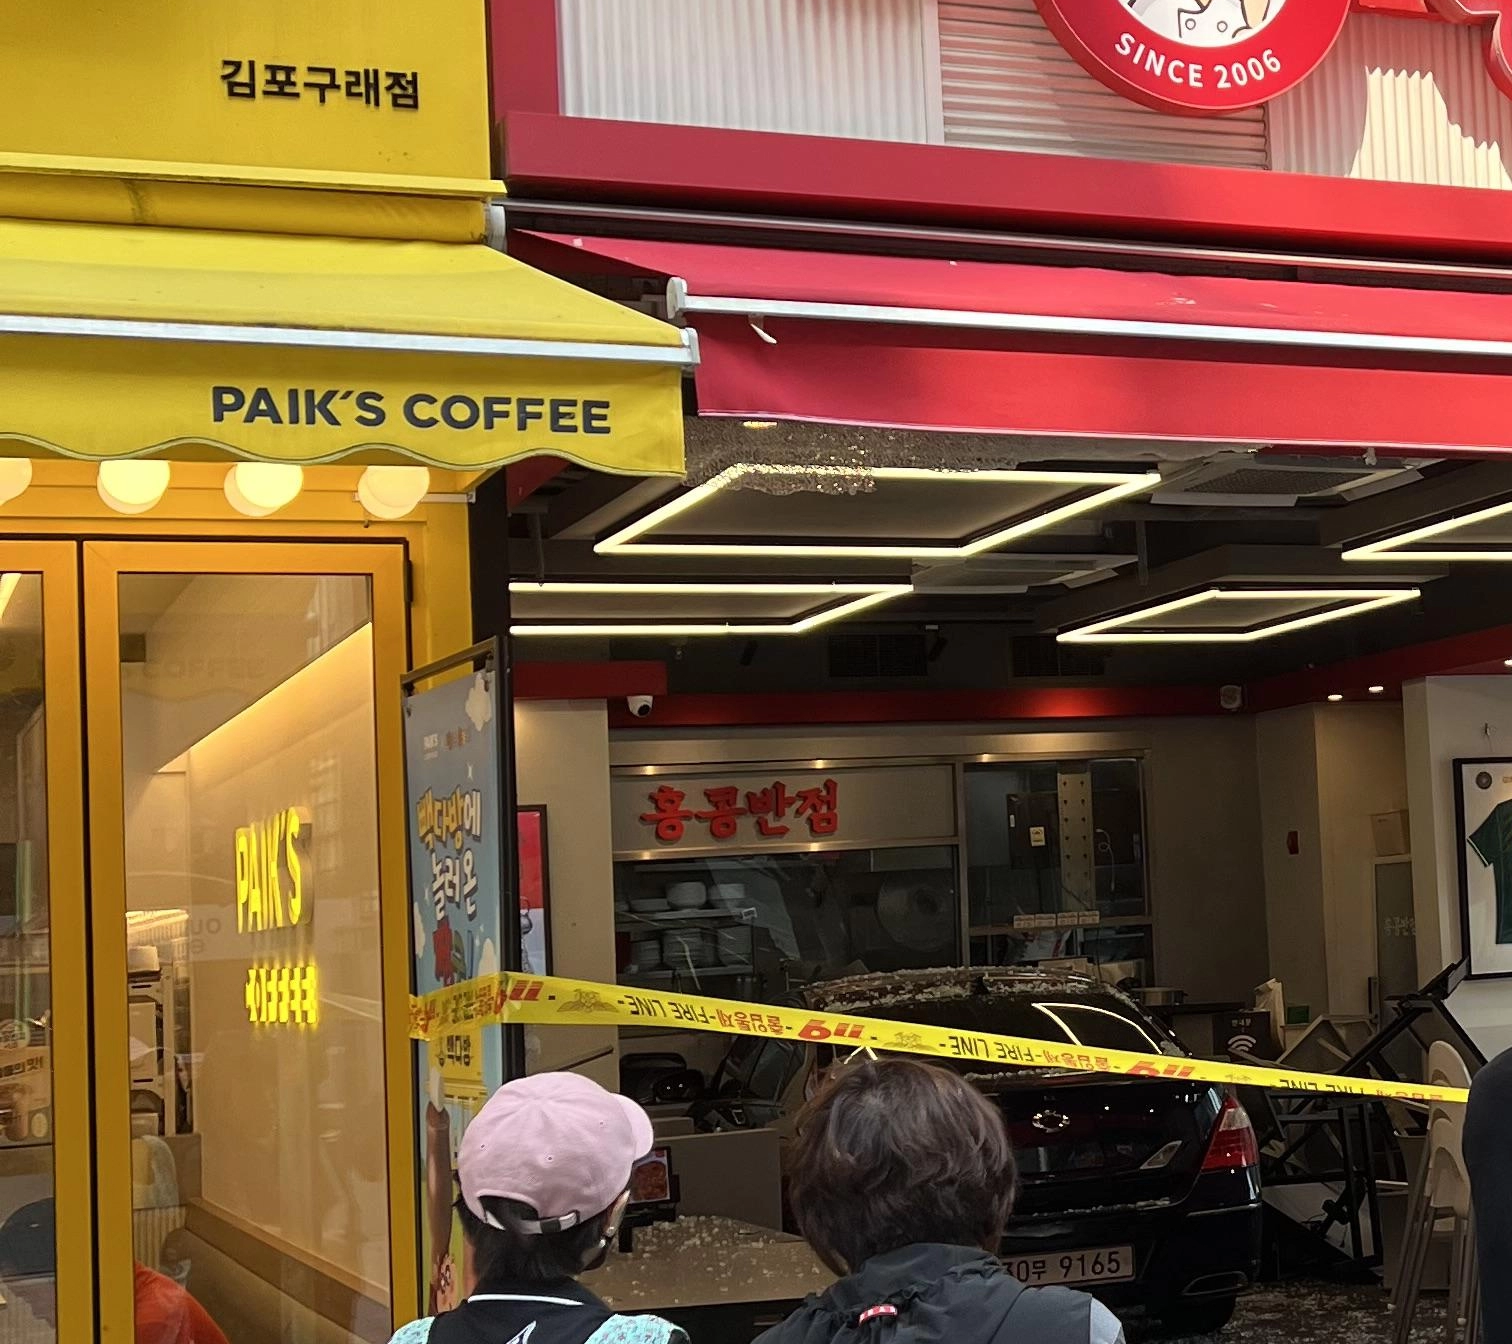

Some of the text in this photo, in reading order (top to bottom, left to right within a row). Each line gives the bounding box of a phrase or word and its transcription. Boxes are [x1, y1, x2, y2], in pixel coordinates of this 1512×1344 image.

[219, 57, 421, 110] 김포구래점
[1113, 30, 1283, 89] SINCE 2006
[211, 385, 611, 434] PAIK'S COFFEE
[416, 783, 482, 852] 빽다방에
[638, 778, 840, 843] 홍콩반점
[235, 806, 302, 935] PAIK'S
[797, 1018, 866, 1043] 119
[1059, 1250, 1120, 1279] 9165
